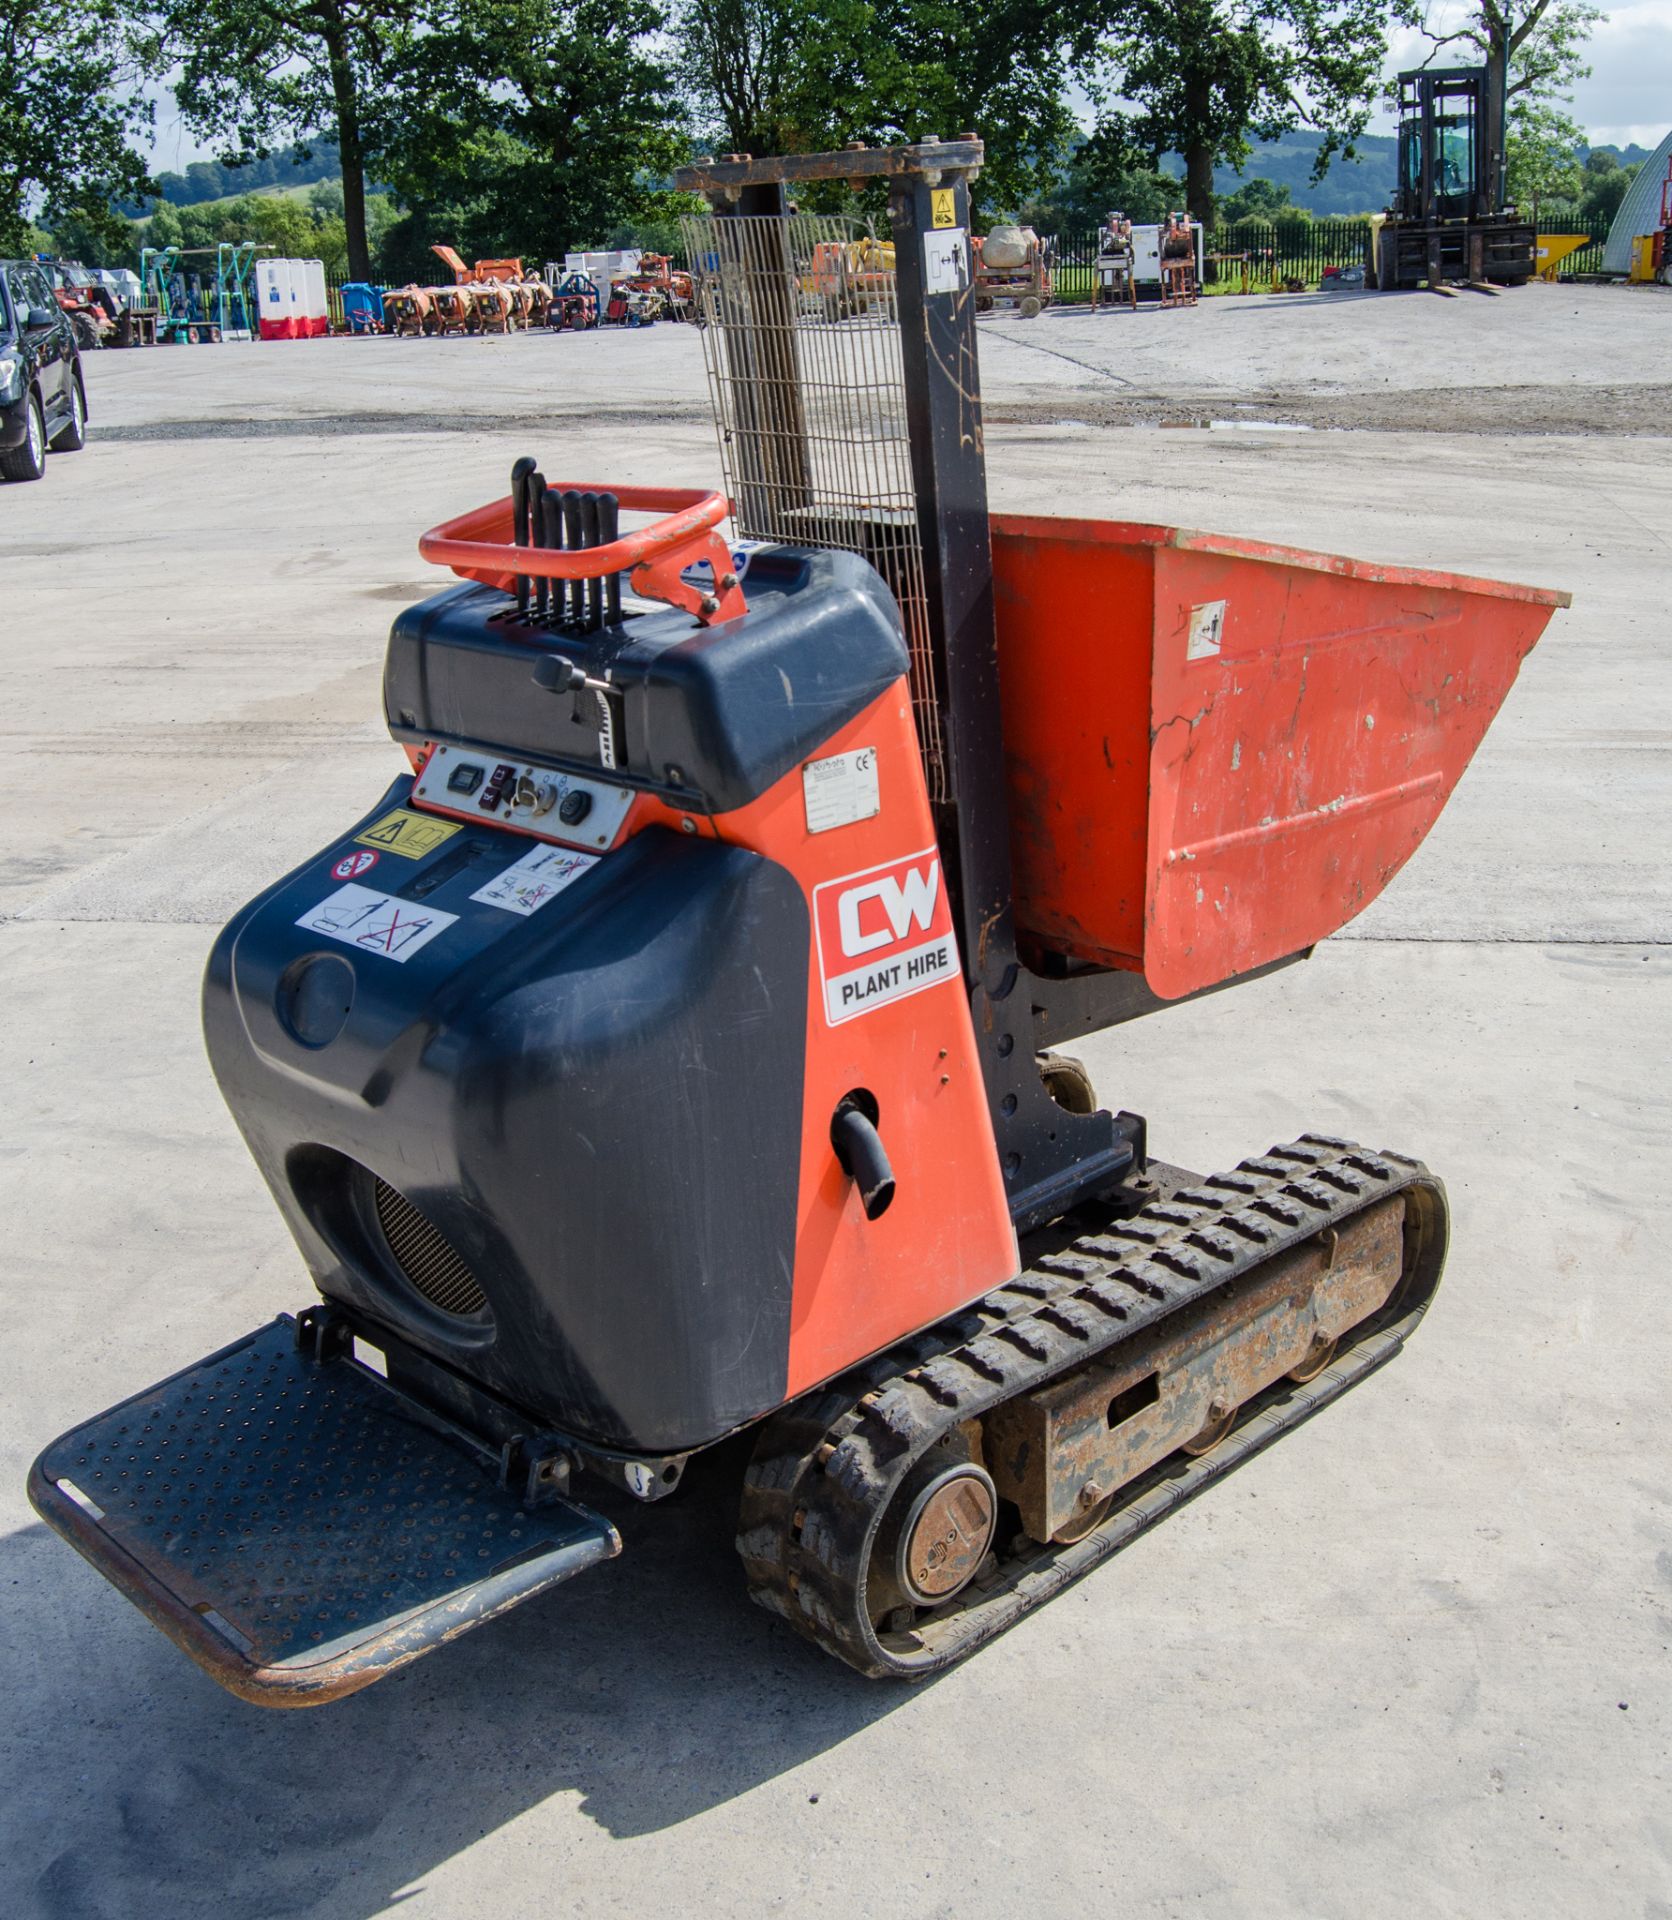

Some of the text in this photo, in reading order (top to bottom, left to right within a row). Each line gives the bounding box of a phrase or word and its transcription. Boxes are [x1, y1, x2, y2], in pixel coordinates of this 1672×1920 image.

[838, 858, 940, 958] CW
[841, 947, 948, 1005] PLANT HIRE
